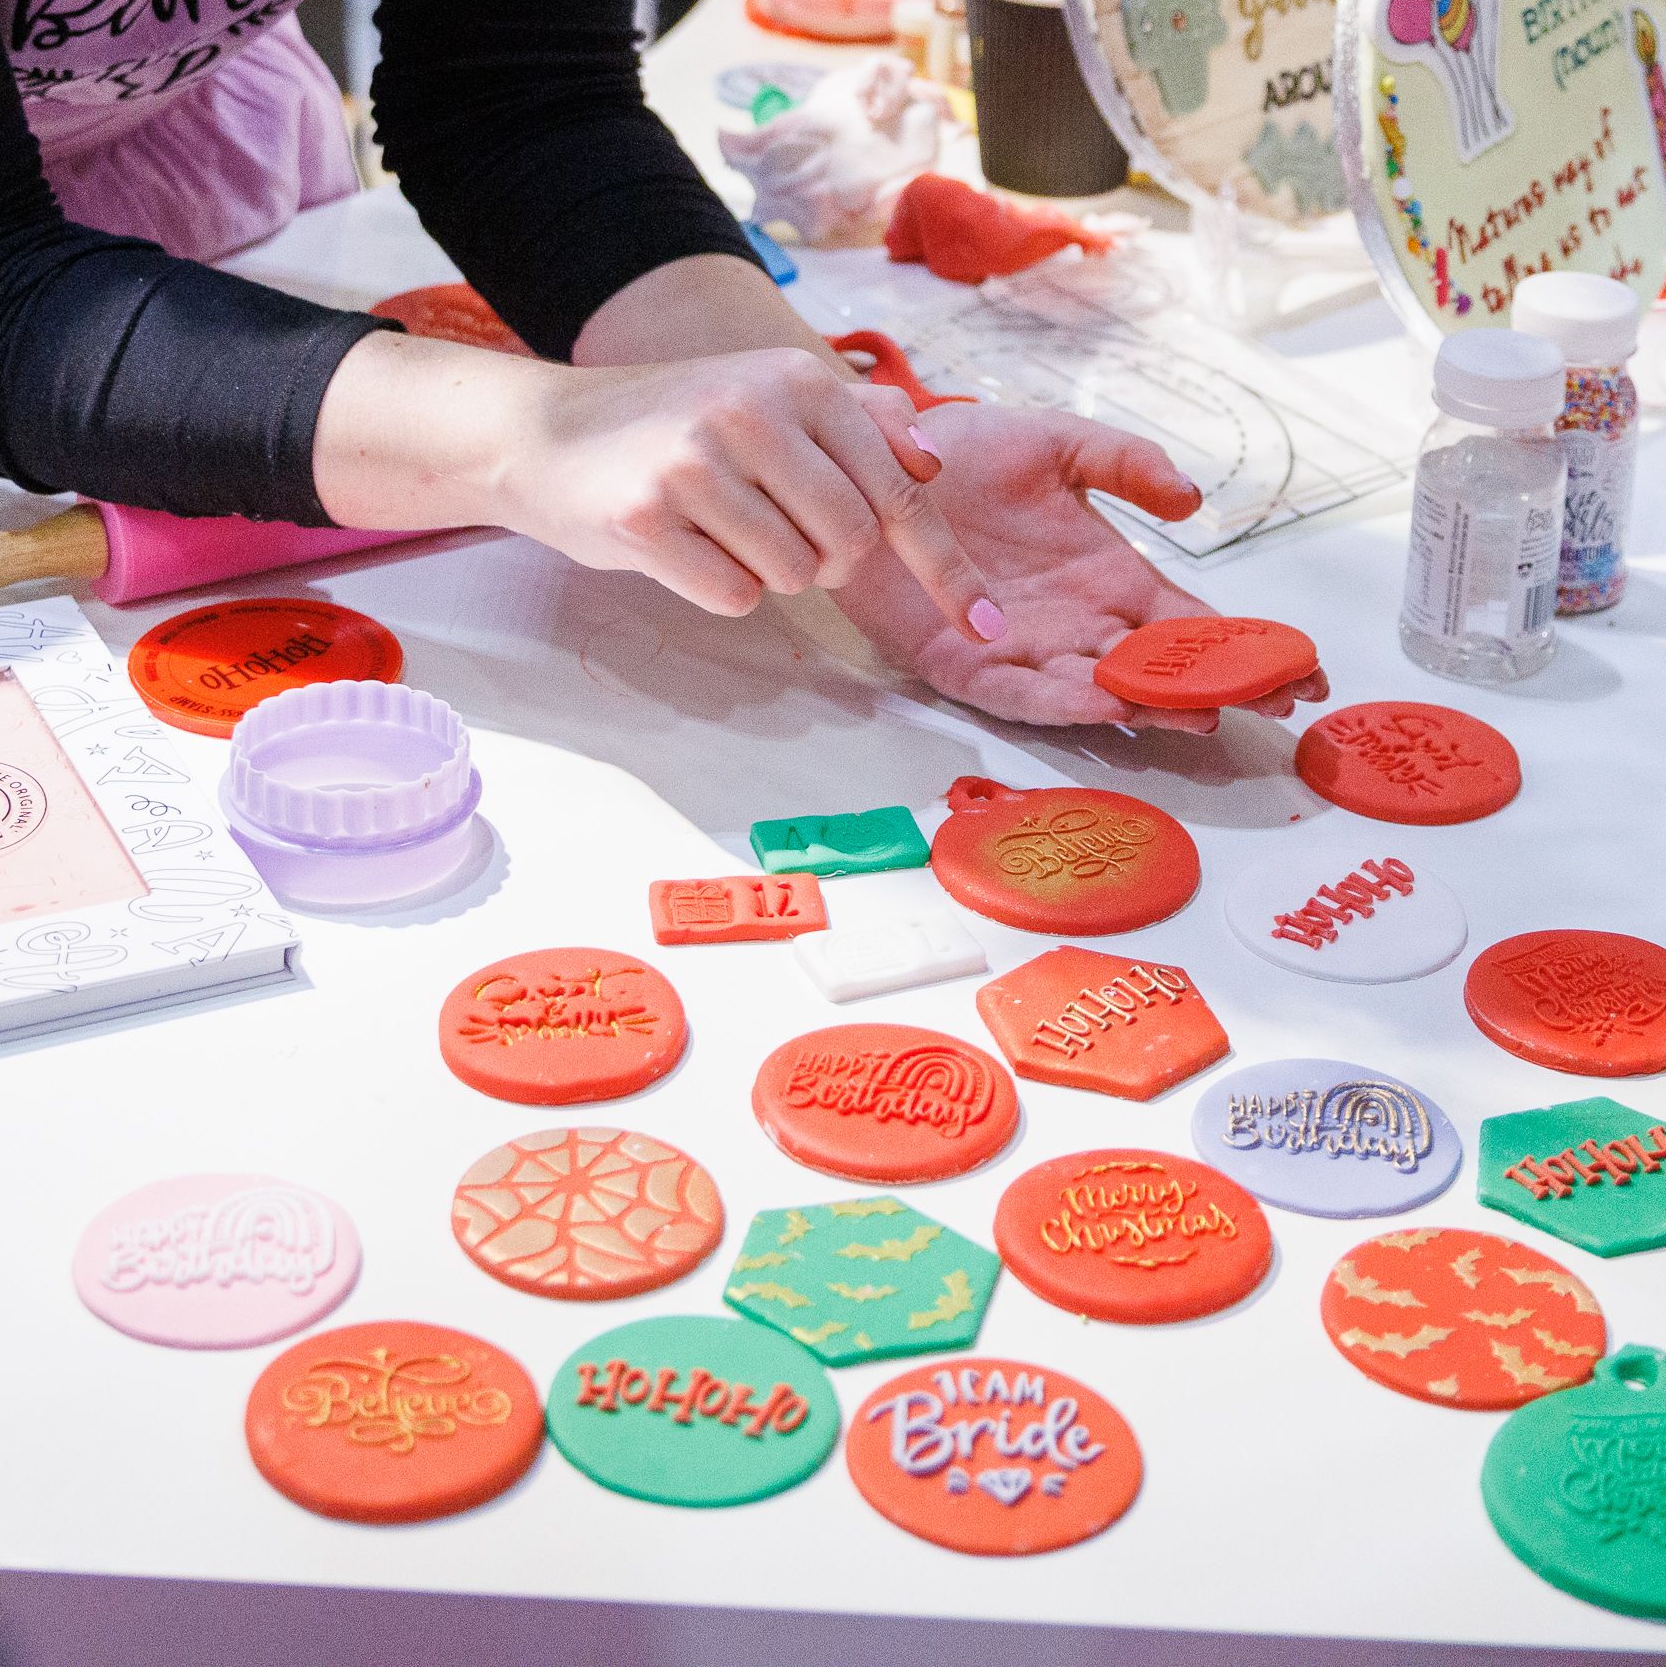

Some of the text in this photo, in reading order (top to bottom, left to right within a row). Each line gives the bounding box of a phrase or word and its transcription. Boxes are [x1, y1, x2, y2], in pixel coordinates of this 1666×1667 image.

[1262, 58, 1333, 114] AROU
[169, 695, 218, 716] STAMP
[9, 782, 34, 832] ORIGINAL
[996, 808, 1157, 879] Believe
[757, 882, 800, 919] 12
[794, 1051, 891, 1081] HAPPY
[782, 1072, 973, 1138] Birthday
[1229, 1089, 1318, 1124] HAPPY
[1221, 1115, 1420, 1172] Birthday
[1060, 1180, 1198, 1216] Merry
[1040, 1203, 1236, 1253] Christmas
[284, 1354, 512, 1453] Believe
[577, 1359, 810, 1437] HOHOHO
[935, 1369, 1044, 1405] TEAM
[870, 1391, 1106, 1474] Bride
